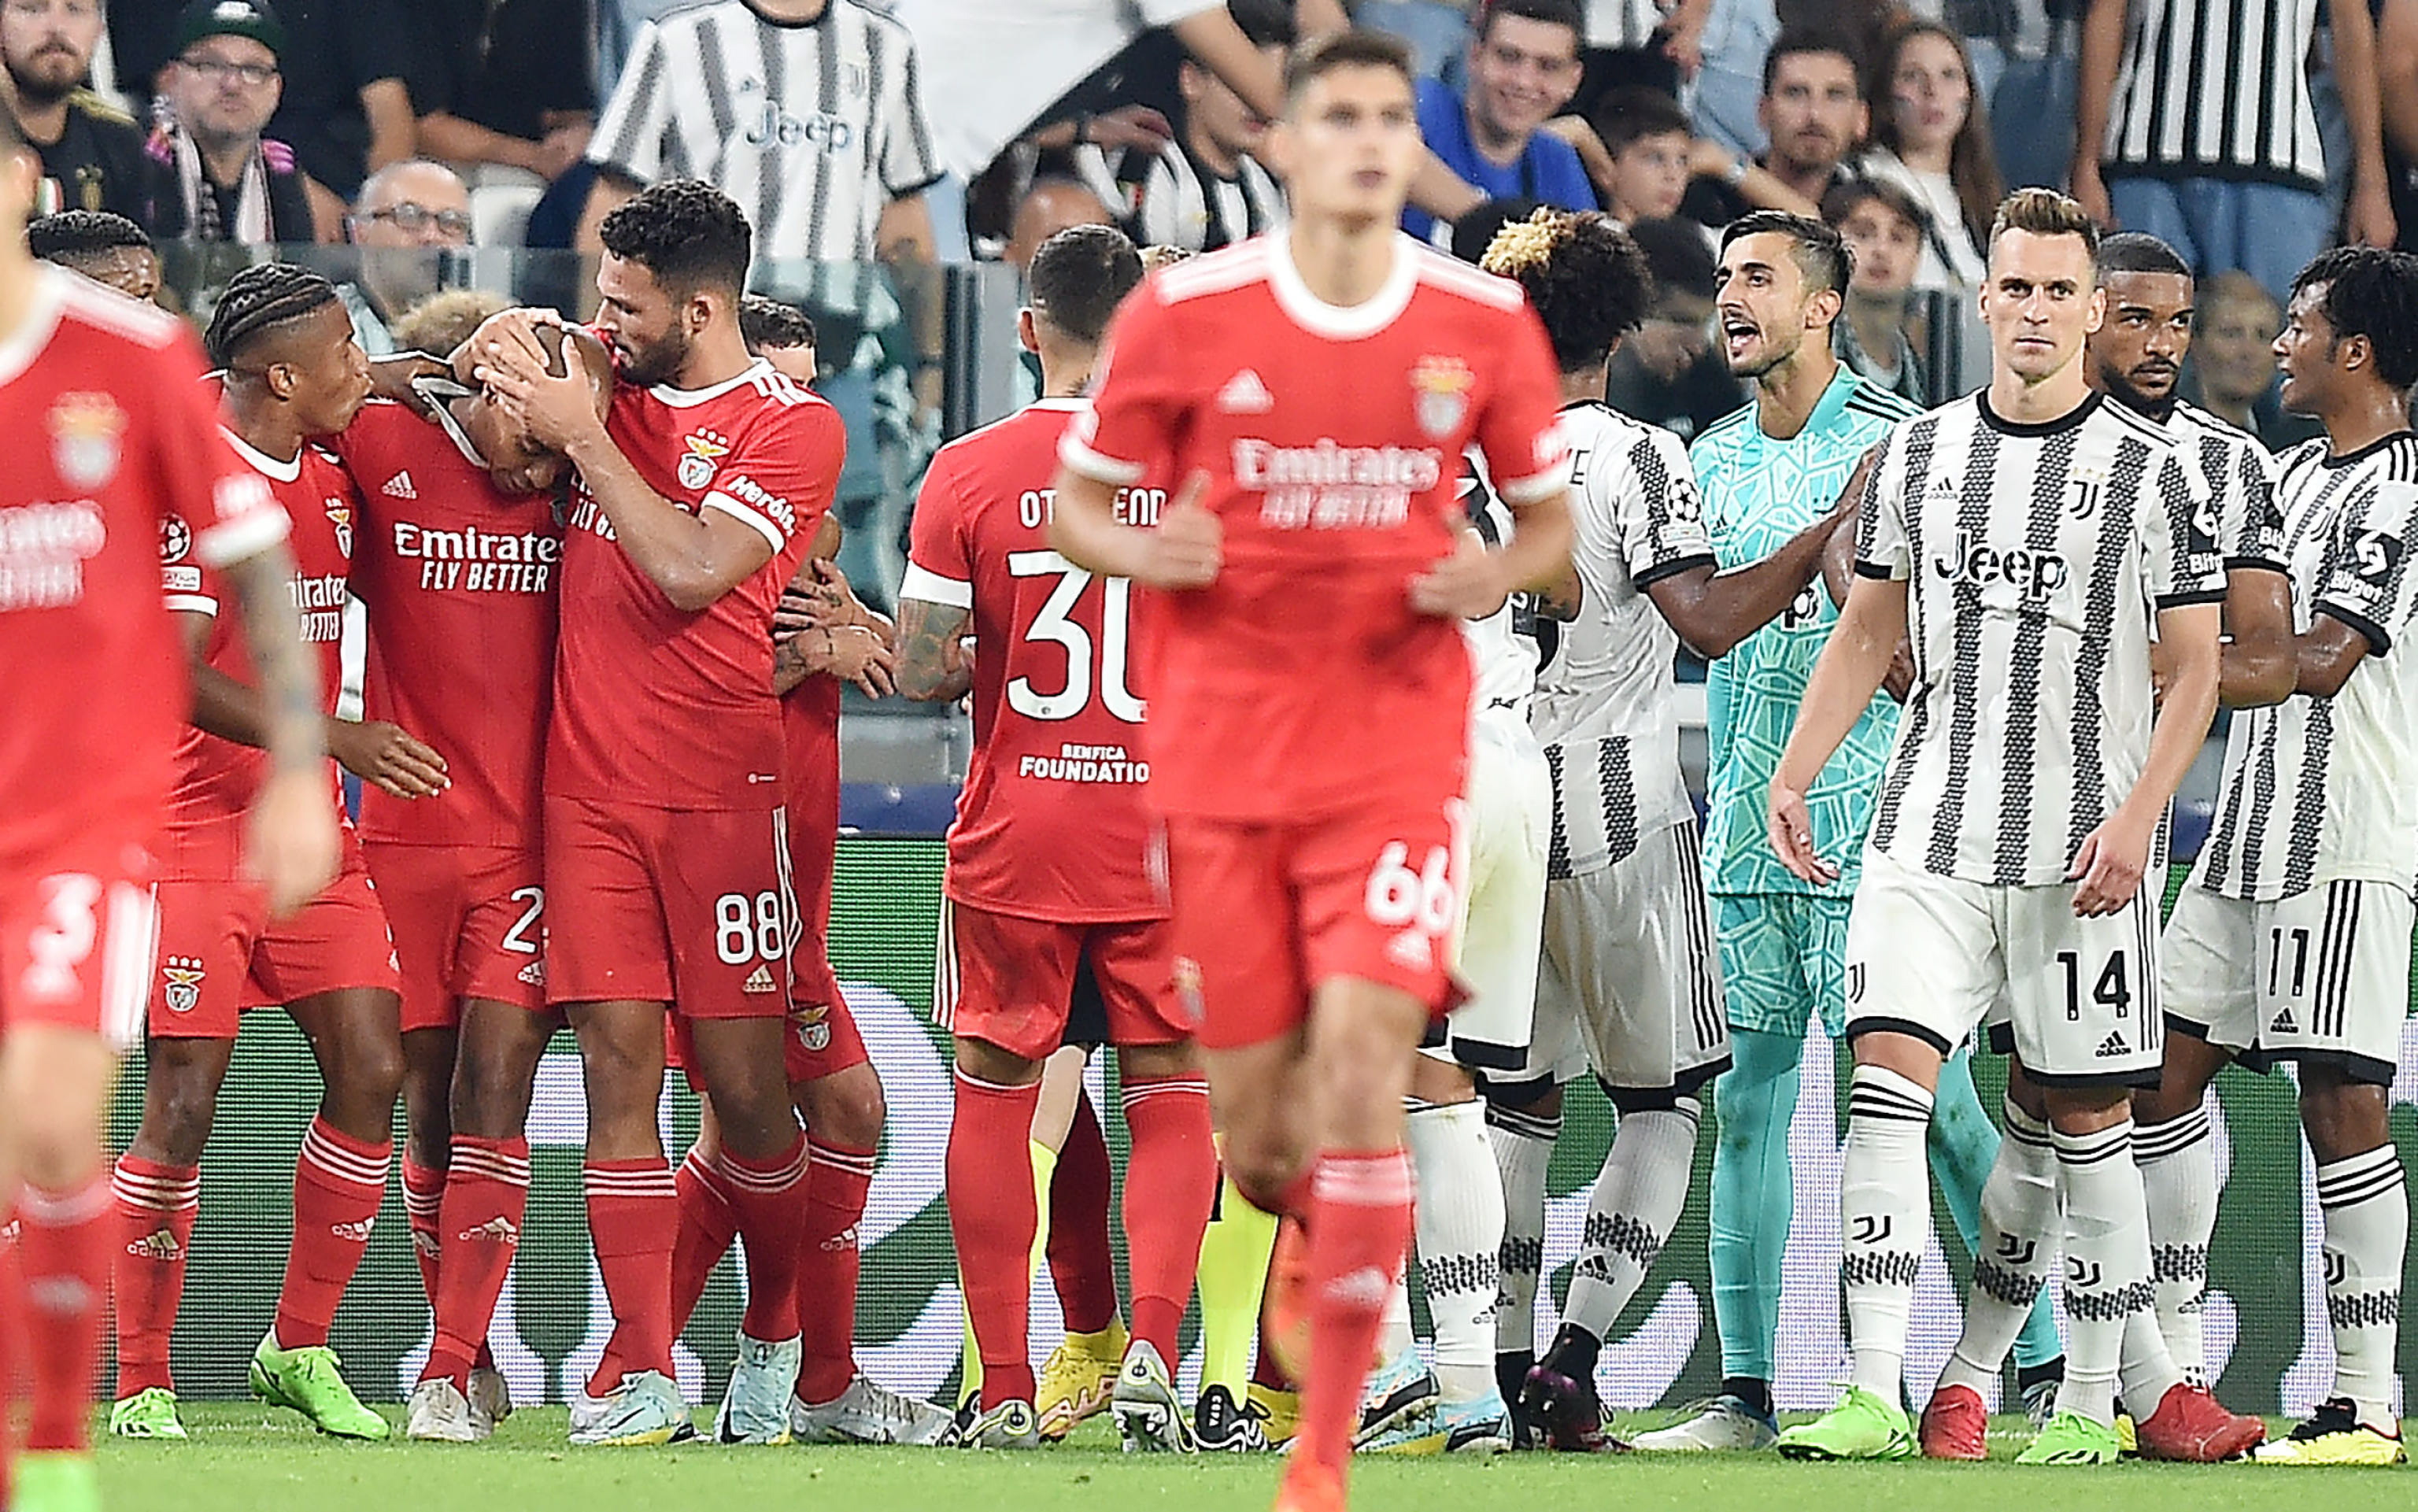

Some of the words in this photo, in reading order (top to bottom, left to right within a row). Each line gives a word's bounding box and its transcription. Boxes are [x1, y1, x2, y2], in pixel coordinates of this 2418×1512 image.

[746, 102, 851, 153] Jeep
[1232, 438, 1442, 491] Emirates
[1020, 489, 1167, 528] OTEND
[420, 561, 461, 590] FLY
[466, 562, 549, 592] BETTER
[1934, 532, 2069, 600] Jeep
[1019, 756, 1150, 782] FOUNDATIO
[1061, 744, 1126, 760] BENFICA
[1365, 839, 1455, 936] 66
[715, 892, 784, 965] 88
[2057, 949, 2131, 1022] 14
[2269, 927, 2311, 997] 11
